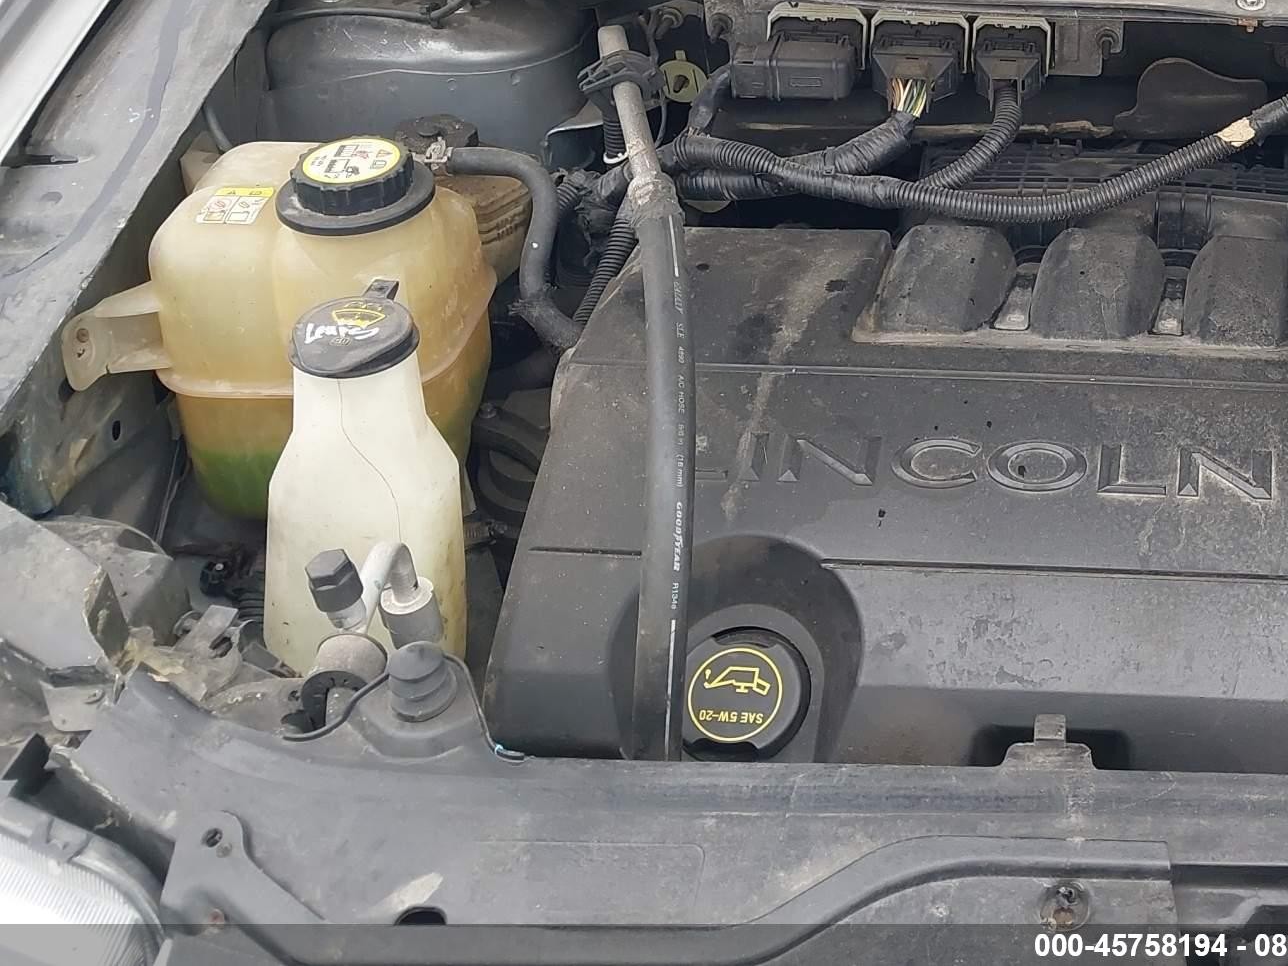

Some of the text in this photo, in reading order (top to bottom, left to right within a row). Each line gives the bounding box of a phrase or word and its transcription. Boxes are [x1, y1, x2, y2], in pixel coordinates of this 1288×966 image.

[672, 501, 684, 572] GOODYEAR
[699, 709, 764, 724] SAE 5W-20
